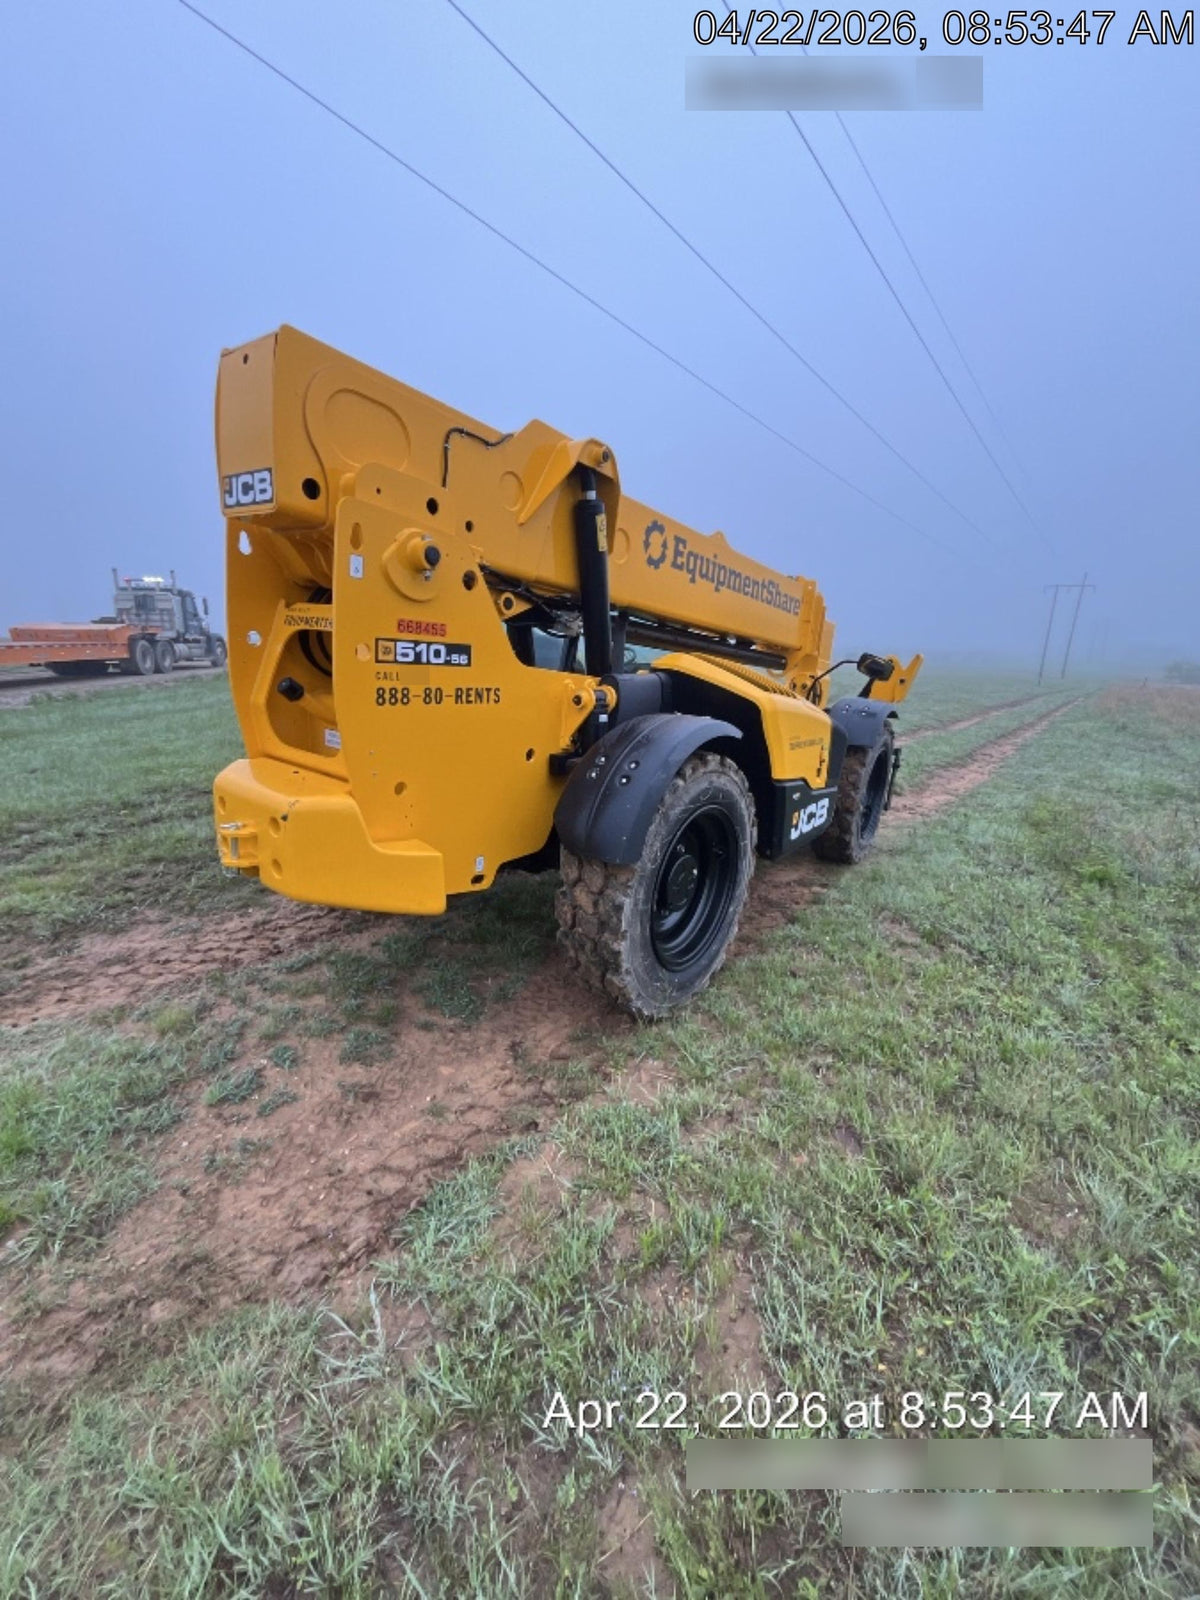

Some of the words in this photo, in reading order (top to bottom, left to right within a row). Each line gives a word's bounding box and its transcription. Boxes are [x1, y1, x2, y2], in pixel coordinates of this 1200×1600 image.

[225, 470, 272, 505] JCB
[671, 535, 800, 616] EquipmentShare
[375, 671, 400, 681] CALL
[376, 687, 501, 706] 888-80-RENTS
[790, 798, 829, 840] JCB
